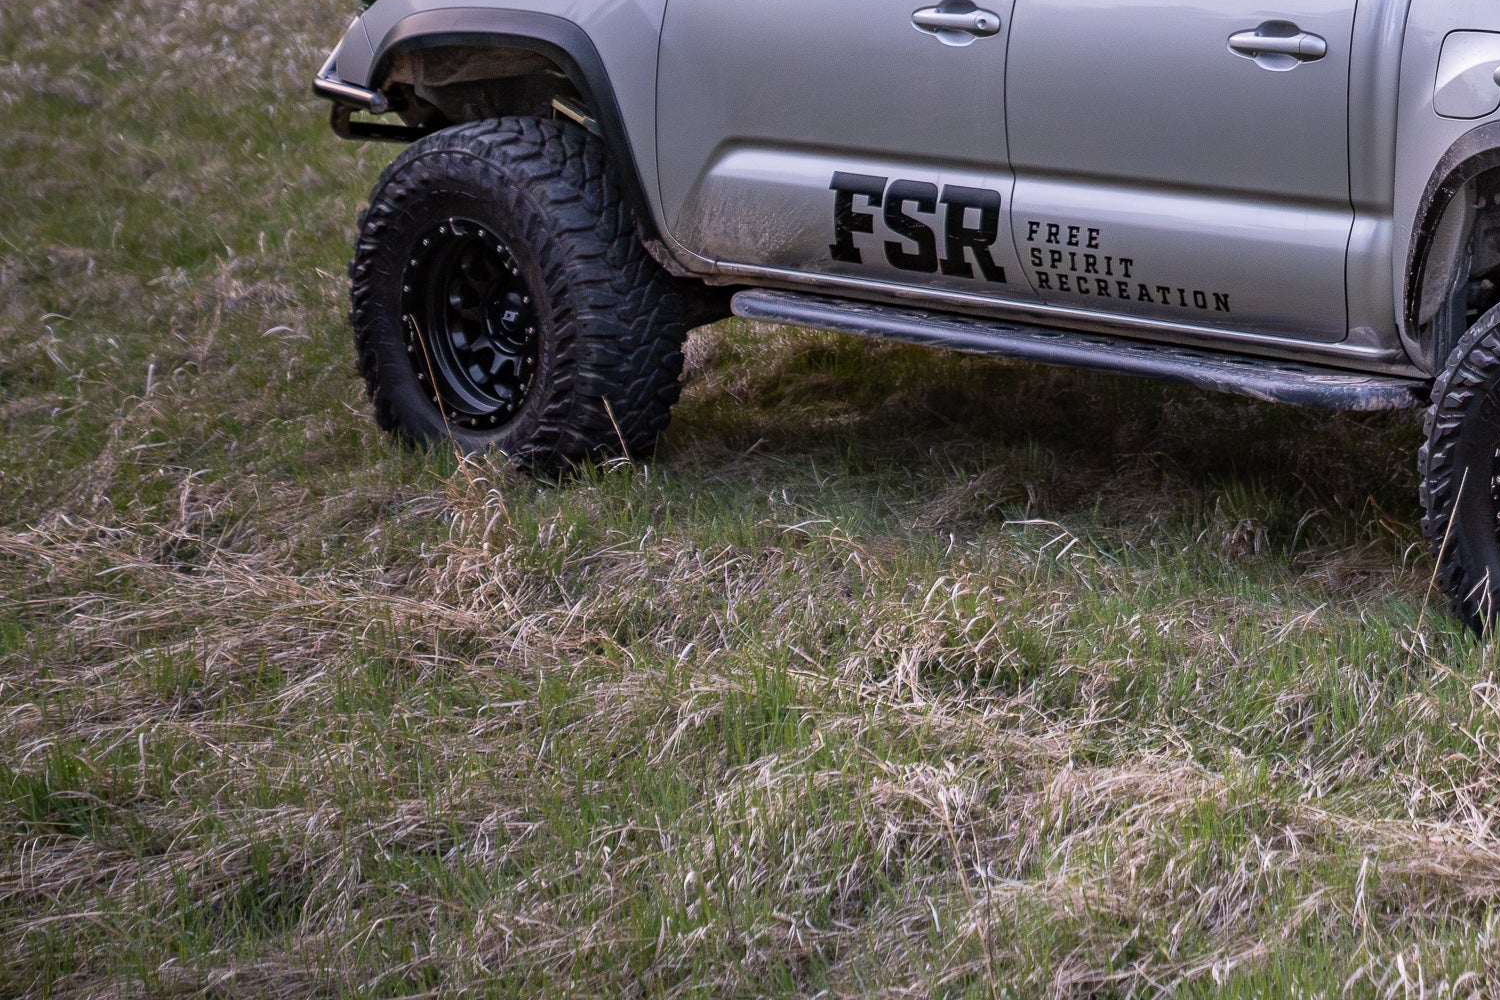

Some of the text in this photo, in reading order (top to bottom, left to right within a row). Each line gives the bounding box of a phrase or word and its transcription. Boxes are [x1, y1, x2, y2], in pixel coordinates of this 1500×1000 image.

[829, 170, 1007, 284] FSR
[1026, 220, 1100, 250] FREE
[1030, 247, 1134, 278] SPIRIT
[1035, 271, 1232, 313] RECREATION
